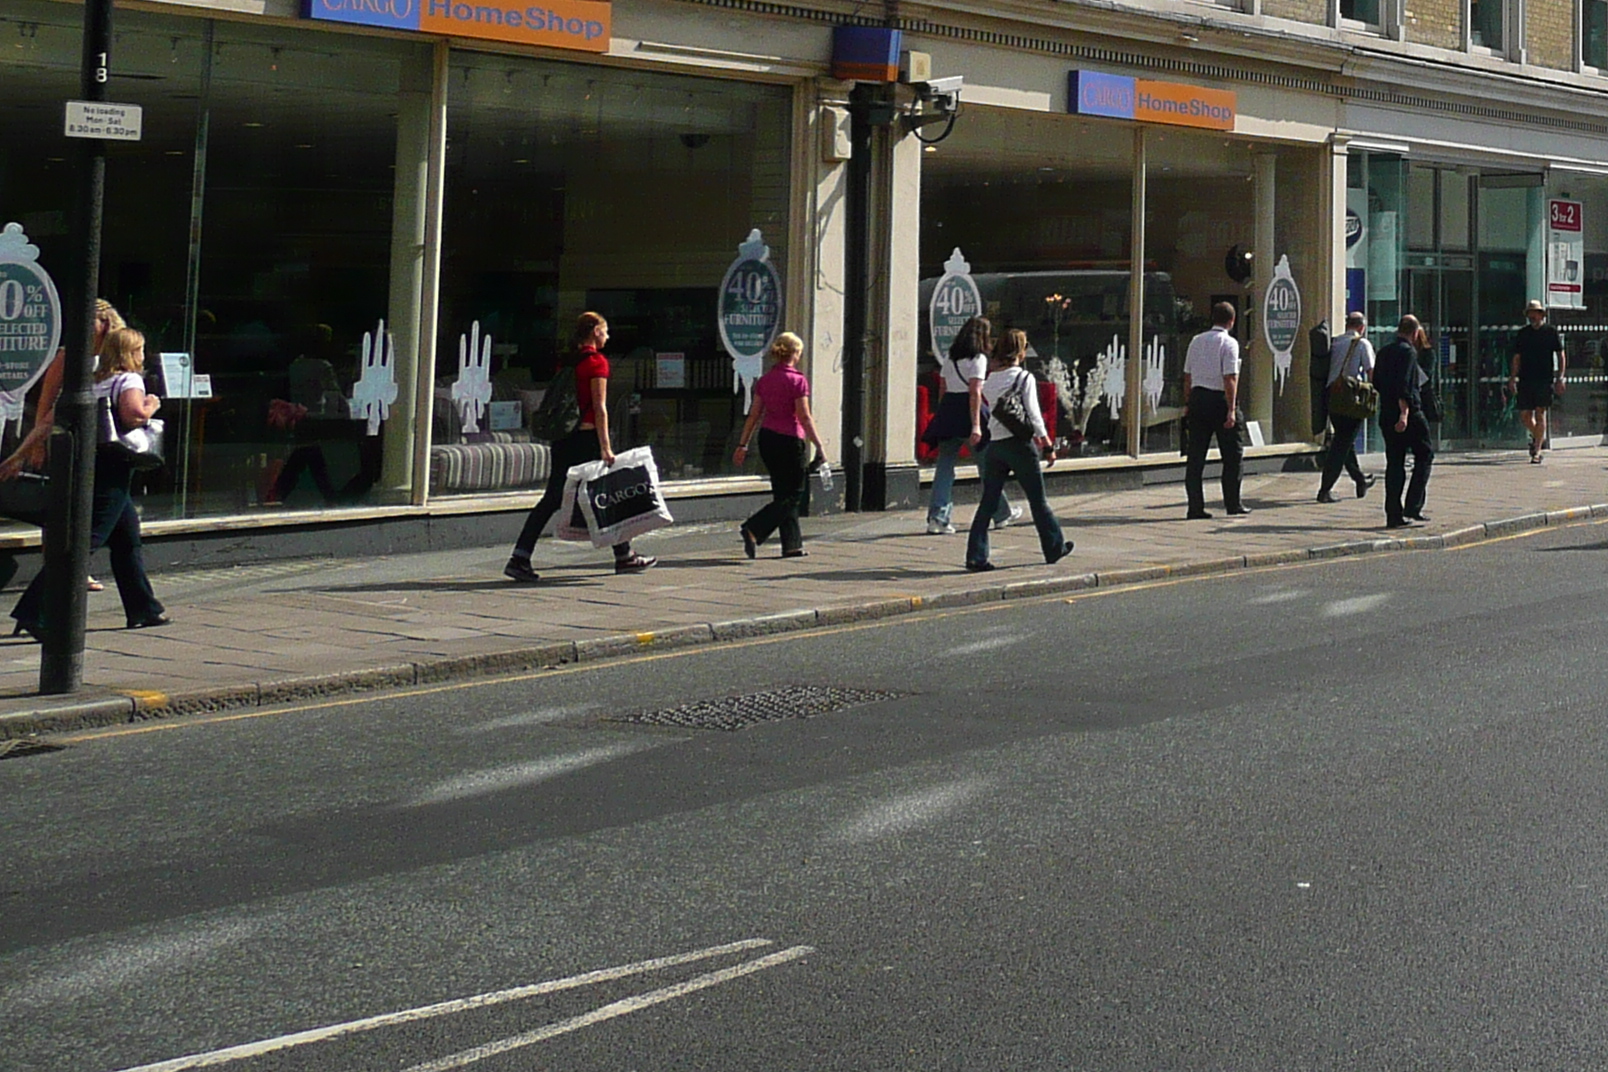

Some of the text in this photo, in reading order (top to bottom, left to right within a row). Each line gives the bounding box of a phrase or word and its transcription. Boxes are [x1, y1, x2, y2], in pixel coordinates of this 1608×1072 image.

[1083, 82, 1232, 122] CARGO HomeShop
[1551, 203, 1559, 221] 3
[1567, 206, 1575, 223] 2
[24, 304, 48, 318] OFF
